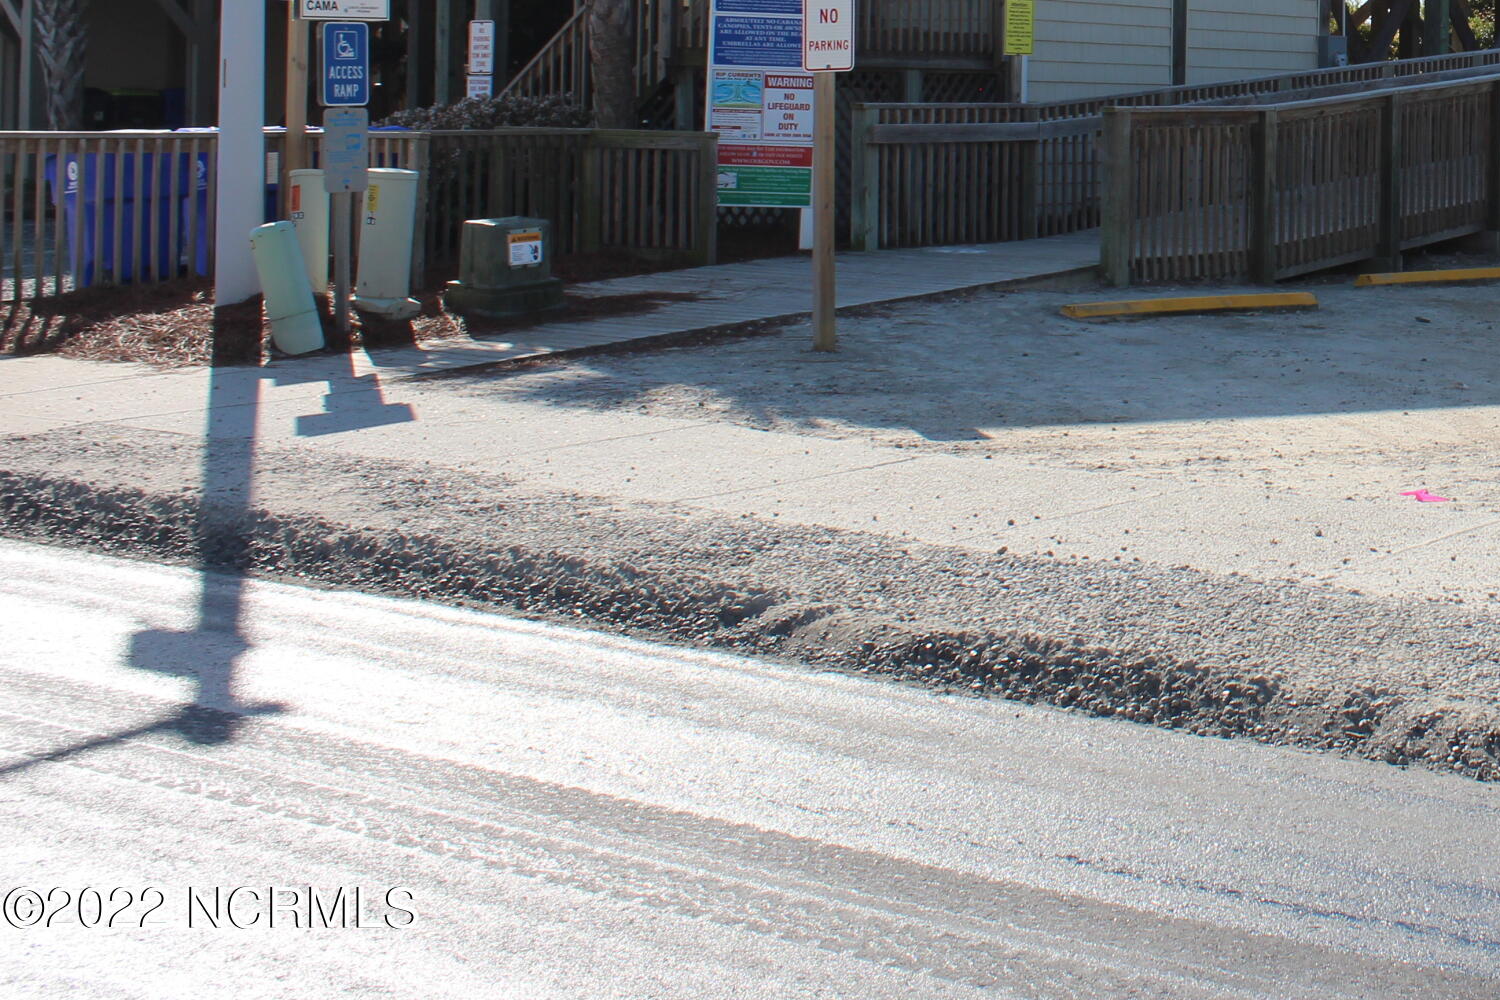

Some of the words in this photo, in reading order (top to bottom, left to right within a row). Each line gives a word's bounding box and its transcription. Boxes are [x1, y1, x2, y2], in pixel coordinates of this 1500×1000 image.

[306, 0, 339, 11] CAMA
[820, 8, 838, 24] NO
[809, 40, 849, 51] PARKING
[328, 66, 363, 79] ACCESS
[768, 77, 813, 88] WARNING
[334, 84, 359, 97] RAMP
[784, 92, 795, 100] NO
[768, 103, 810, 111] LIFEGUARD
[778, 122, 799, 131] DUTY
